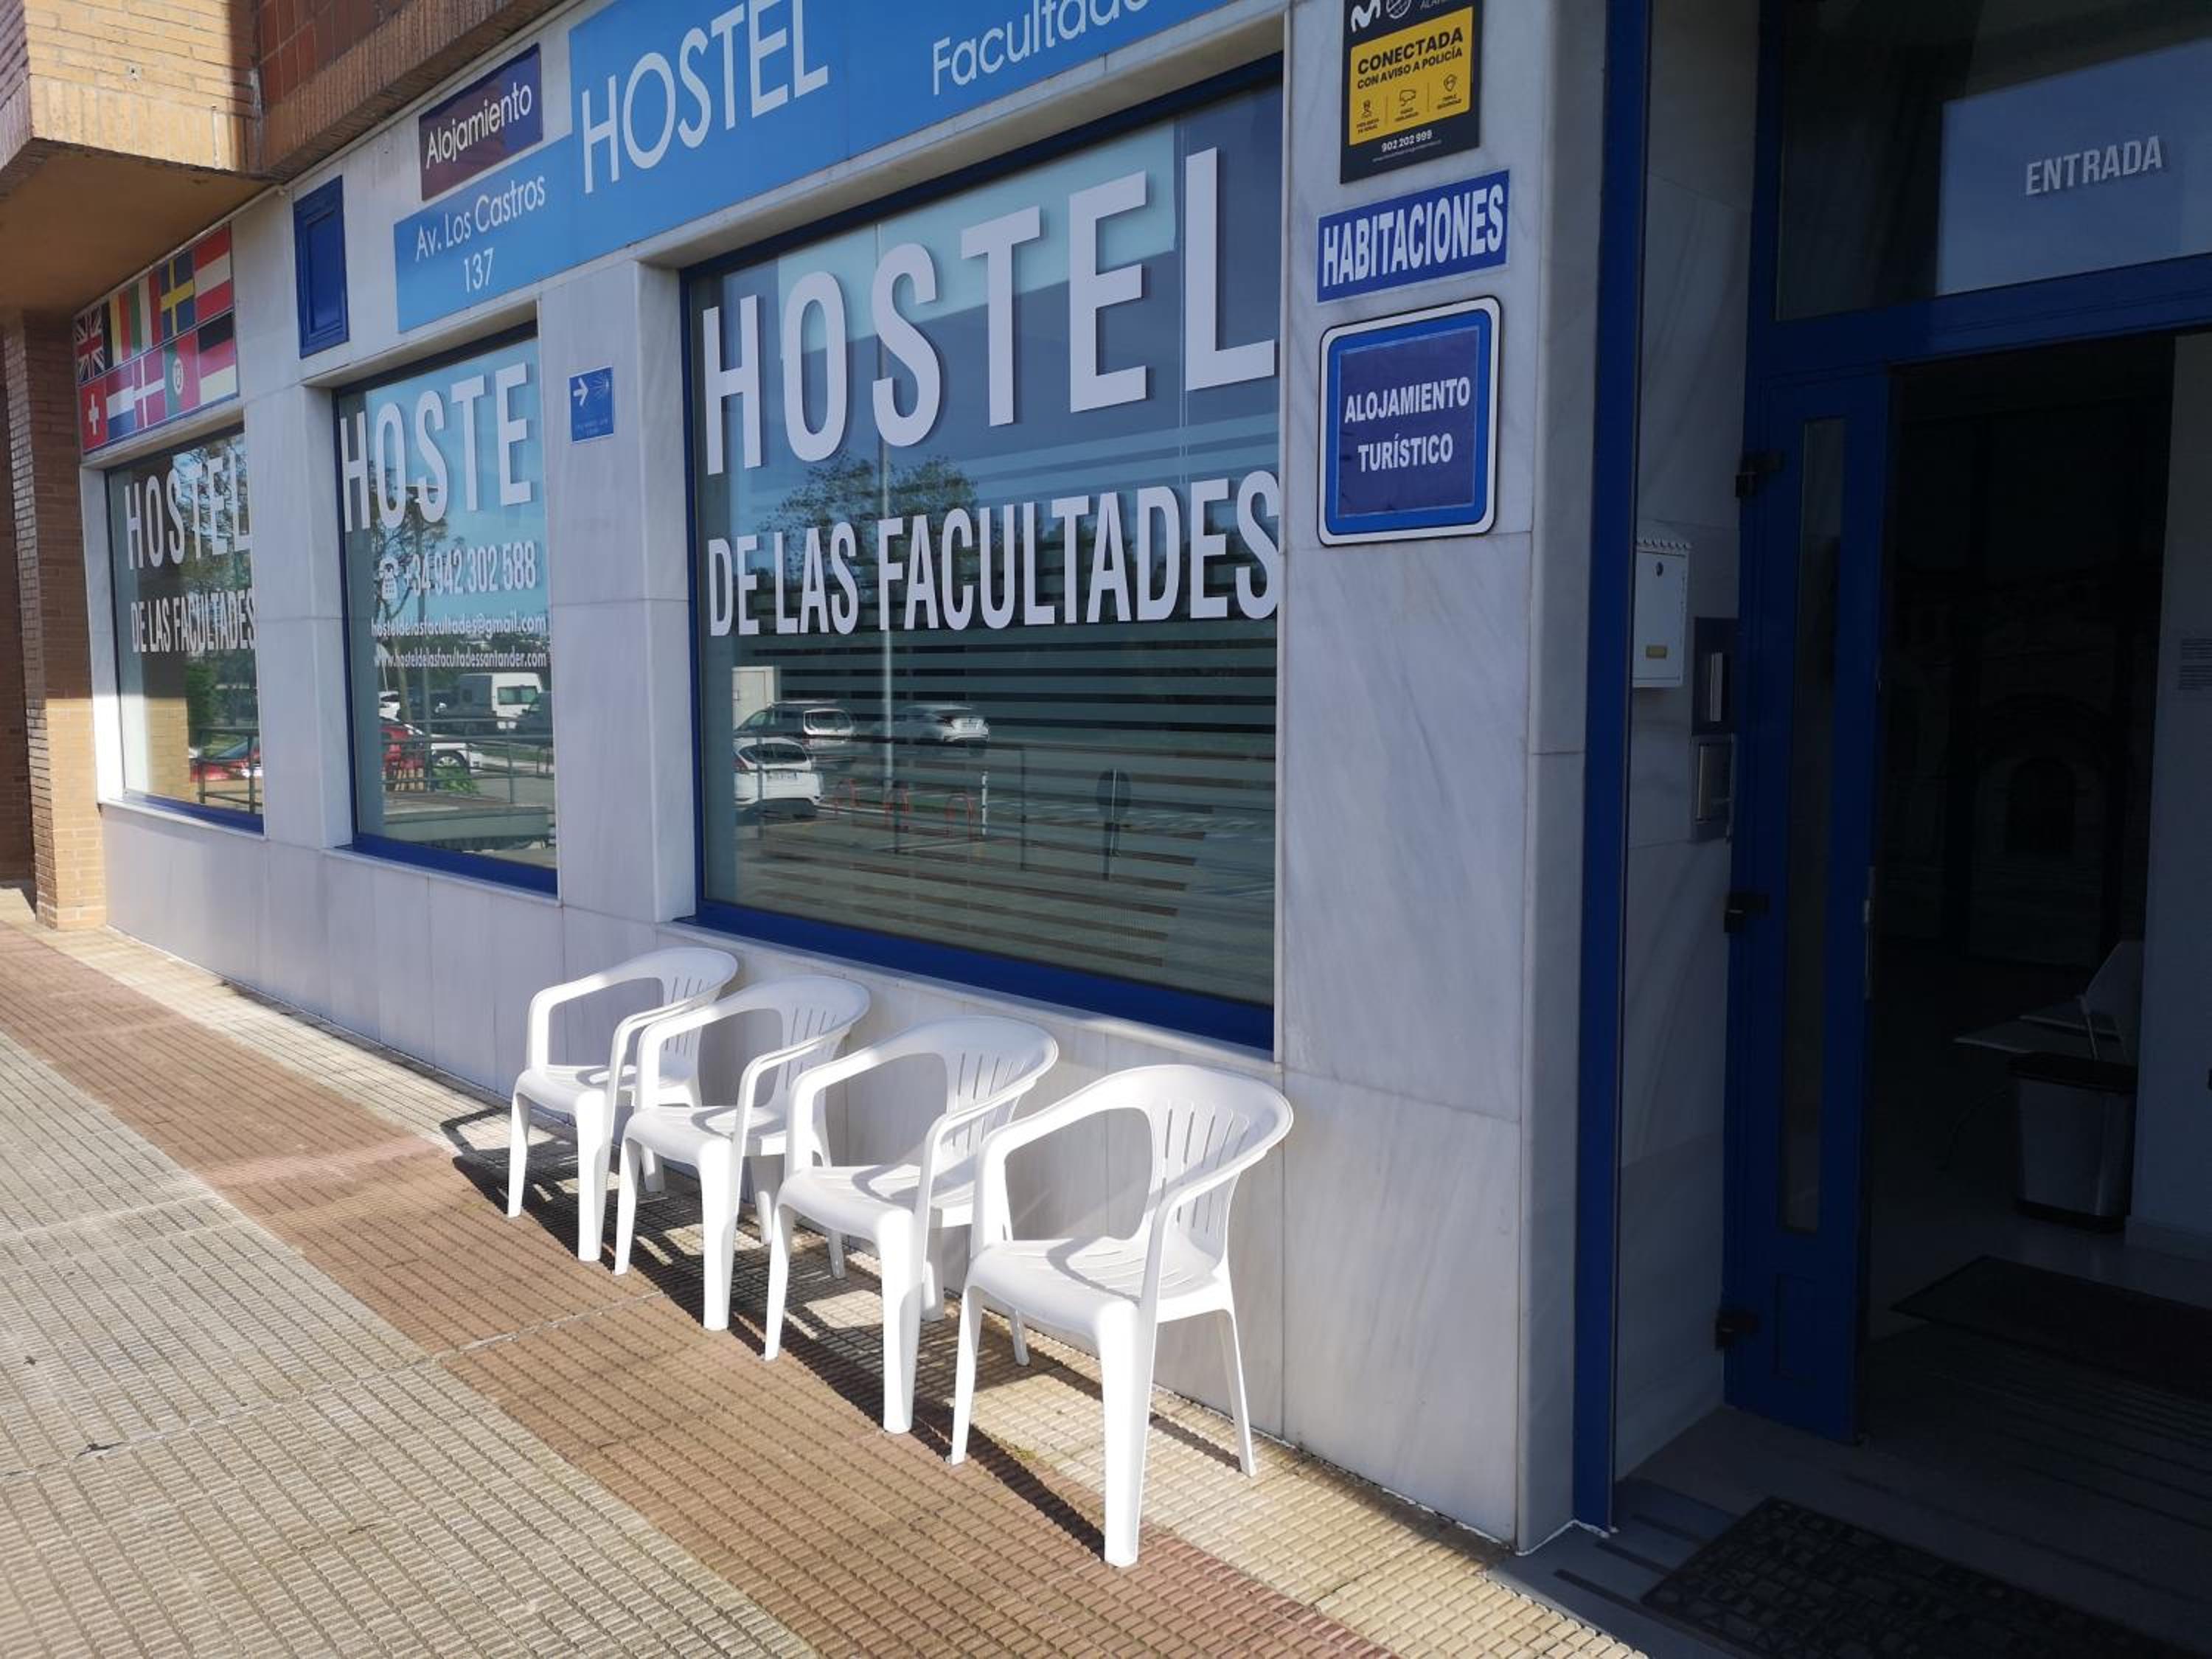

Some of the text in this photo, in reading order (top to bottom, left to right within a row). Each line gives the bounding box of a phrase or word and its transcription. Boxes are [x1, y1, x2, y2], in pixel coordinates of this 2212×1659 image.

[1357, 27, 1464, 74] CONECTADA
[1357, 46, 1462, 89] CON AVISO A POLICÍA
[425, 82, 532, 170] Alojamiento
[582, 0, 829, 194] HOSTEL
[1382, 139, 1397, 153] 902
[1399, 135, 1415, 148] 202
[2025, 135, 2162, 195] ENTRADA
[416, 175, 546, 262] Av. Los Castros
[1322, 184, 1504, 287] HABITACIONES
[464, 248, 494, 293] 137
[703, 147, 1276, 476] HOSTEL
[1345, 377, 1471, 423] ALOJAMIENTO
[1357, 433, 1453, 473] TURÍSTICO
[125, 447, 252, 570] HOSTEL
[708, 470, 1280, 636] DE LAS FACULTADES
[131, 588, 257, 653] DE LAS FACULTADES
